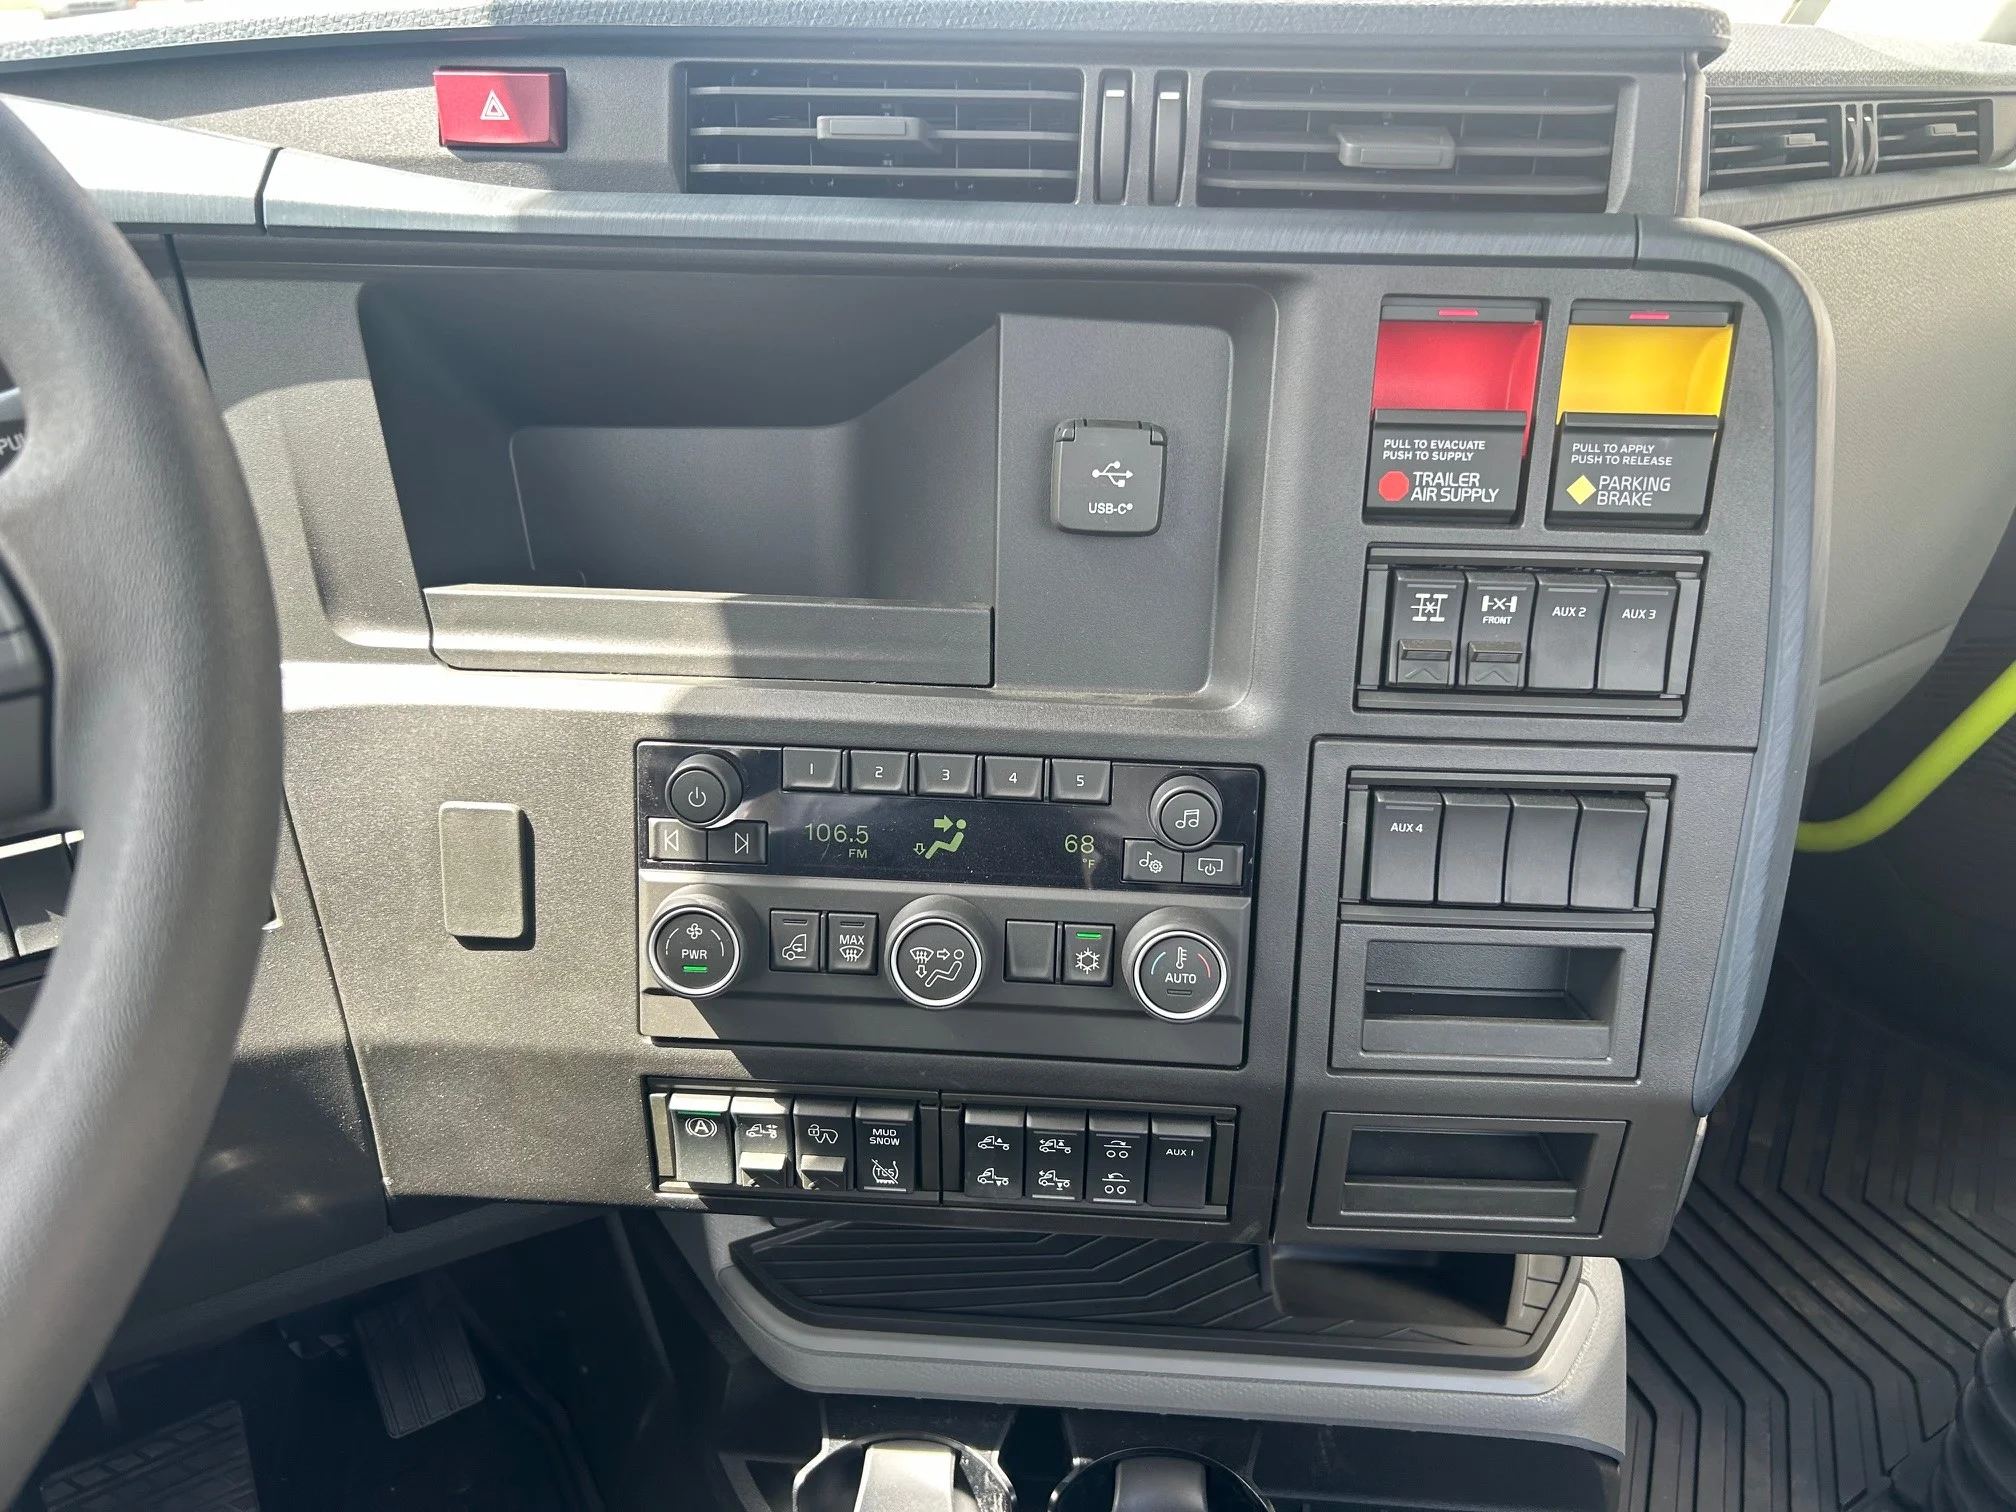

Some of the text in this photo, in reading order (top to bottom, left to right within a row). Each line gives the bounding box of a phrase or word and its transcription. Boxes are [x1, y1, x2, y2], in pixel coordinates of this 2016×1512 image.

[1383, 438, 1486, 450] PULL TO EVACUATE
[1572, 443, 1655, 454] PULL TO APPLY
[1382, 450, 1474, 461] PUSH TO SUPPLY
[1571, 454, 1673, 466] PUSH TO RELEASE
[1412, 471, 1481, 487] TRAILER
[1598, 475, 1671, 492] PARKING
[1410, 487, 1500, 503] AIR SUPPLY
[1596, 491, 1654, 507] BRAKE
[1551, 606, 1587, 617] AUX 2
[1621, 608, 1656, 619] AUX 3
[1482, 615, 1512, 624] FRONT
[874, 766, 884, 779] 2
[941, 769, 951, 781] 3
[1008, 772, 1019, 784] 4
[1076, 775, 1085, 787] 5
[1390, 822, 1423, 832] AUX 4
[804, 823, 869, 844] 106.5
[1064, 834, 1095, 854] 68
[848, 848, 868, 859] FM
[839, 934, 865, 945] MAX
[681, 949, 707, 960] PWR
[1164, 972, 1197, 984] AUTO
[872, 1128, 897, 1137] MUD
[869, 1136, 901, 1146] SNOW
[1165, 1148, 1187, 1156] AUX
